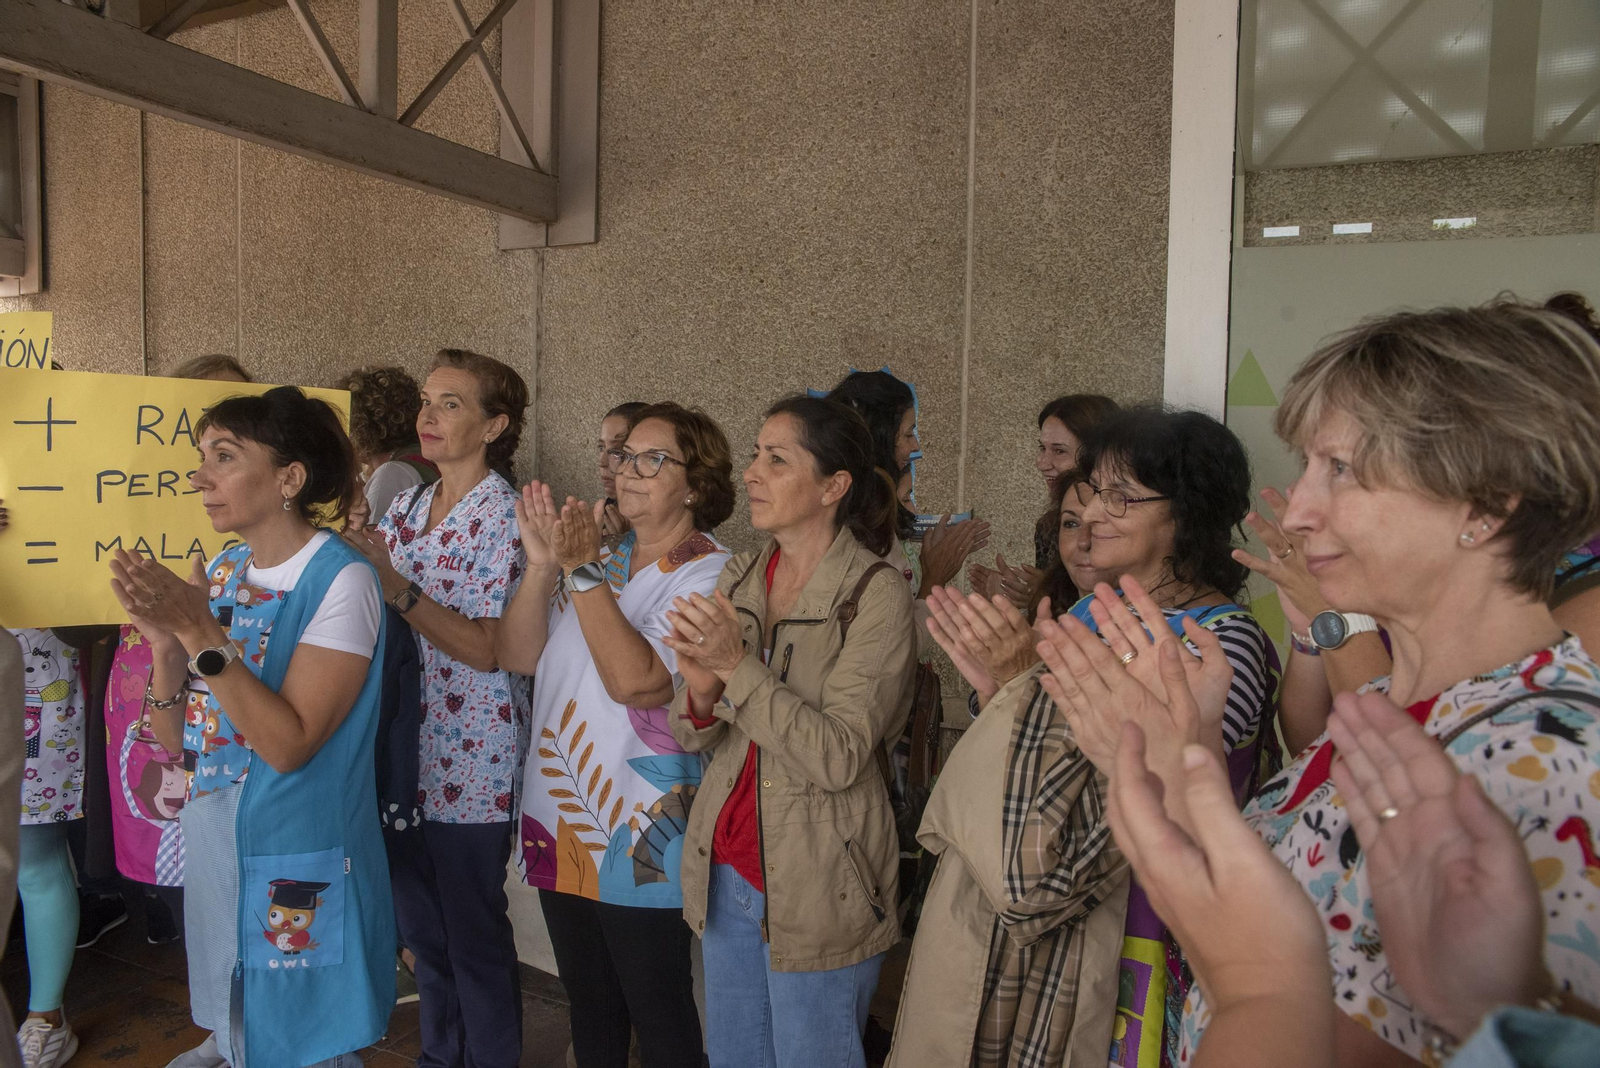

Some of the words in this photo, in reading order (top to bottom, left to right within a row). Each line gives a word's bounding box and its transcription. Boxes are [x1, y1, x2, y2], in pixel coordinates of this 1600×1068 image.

[95, 533, 207, 562] MALA
[437, 555, 463, 572] PILI
[268, 958, 310, 969] OWL
